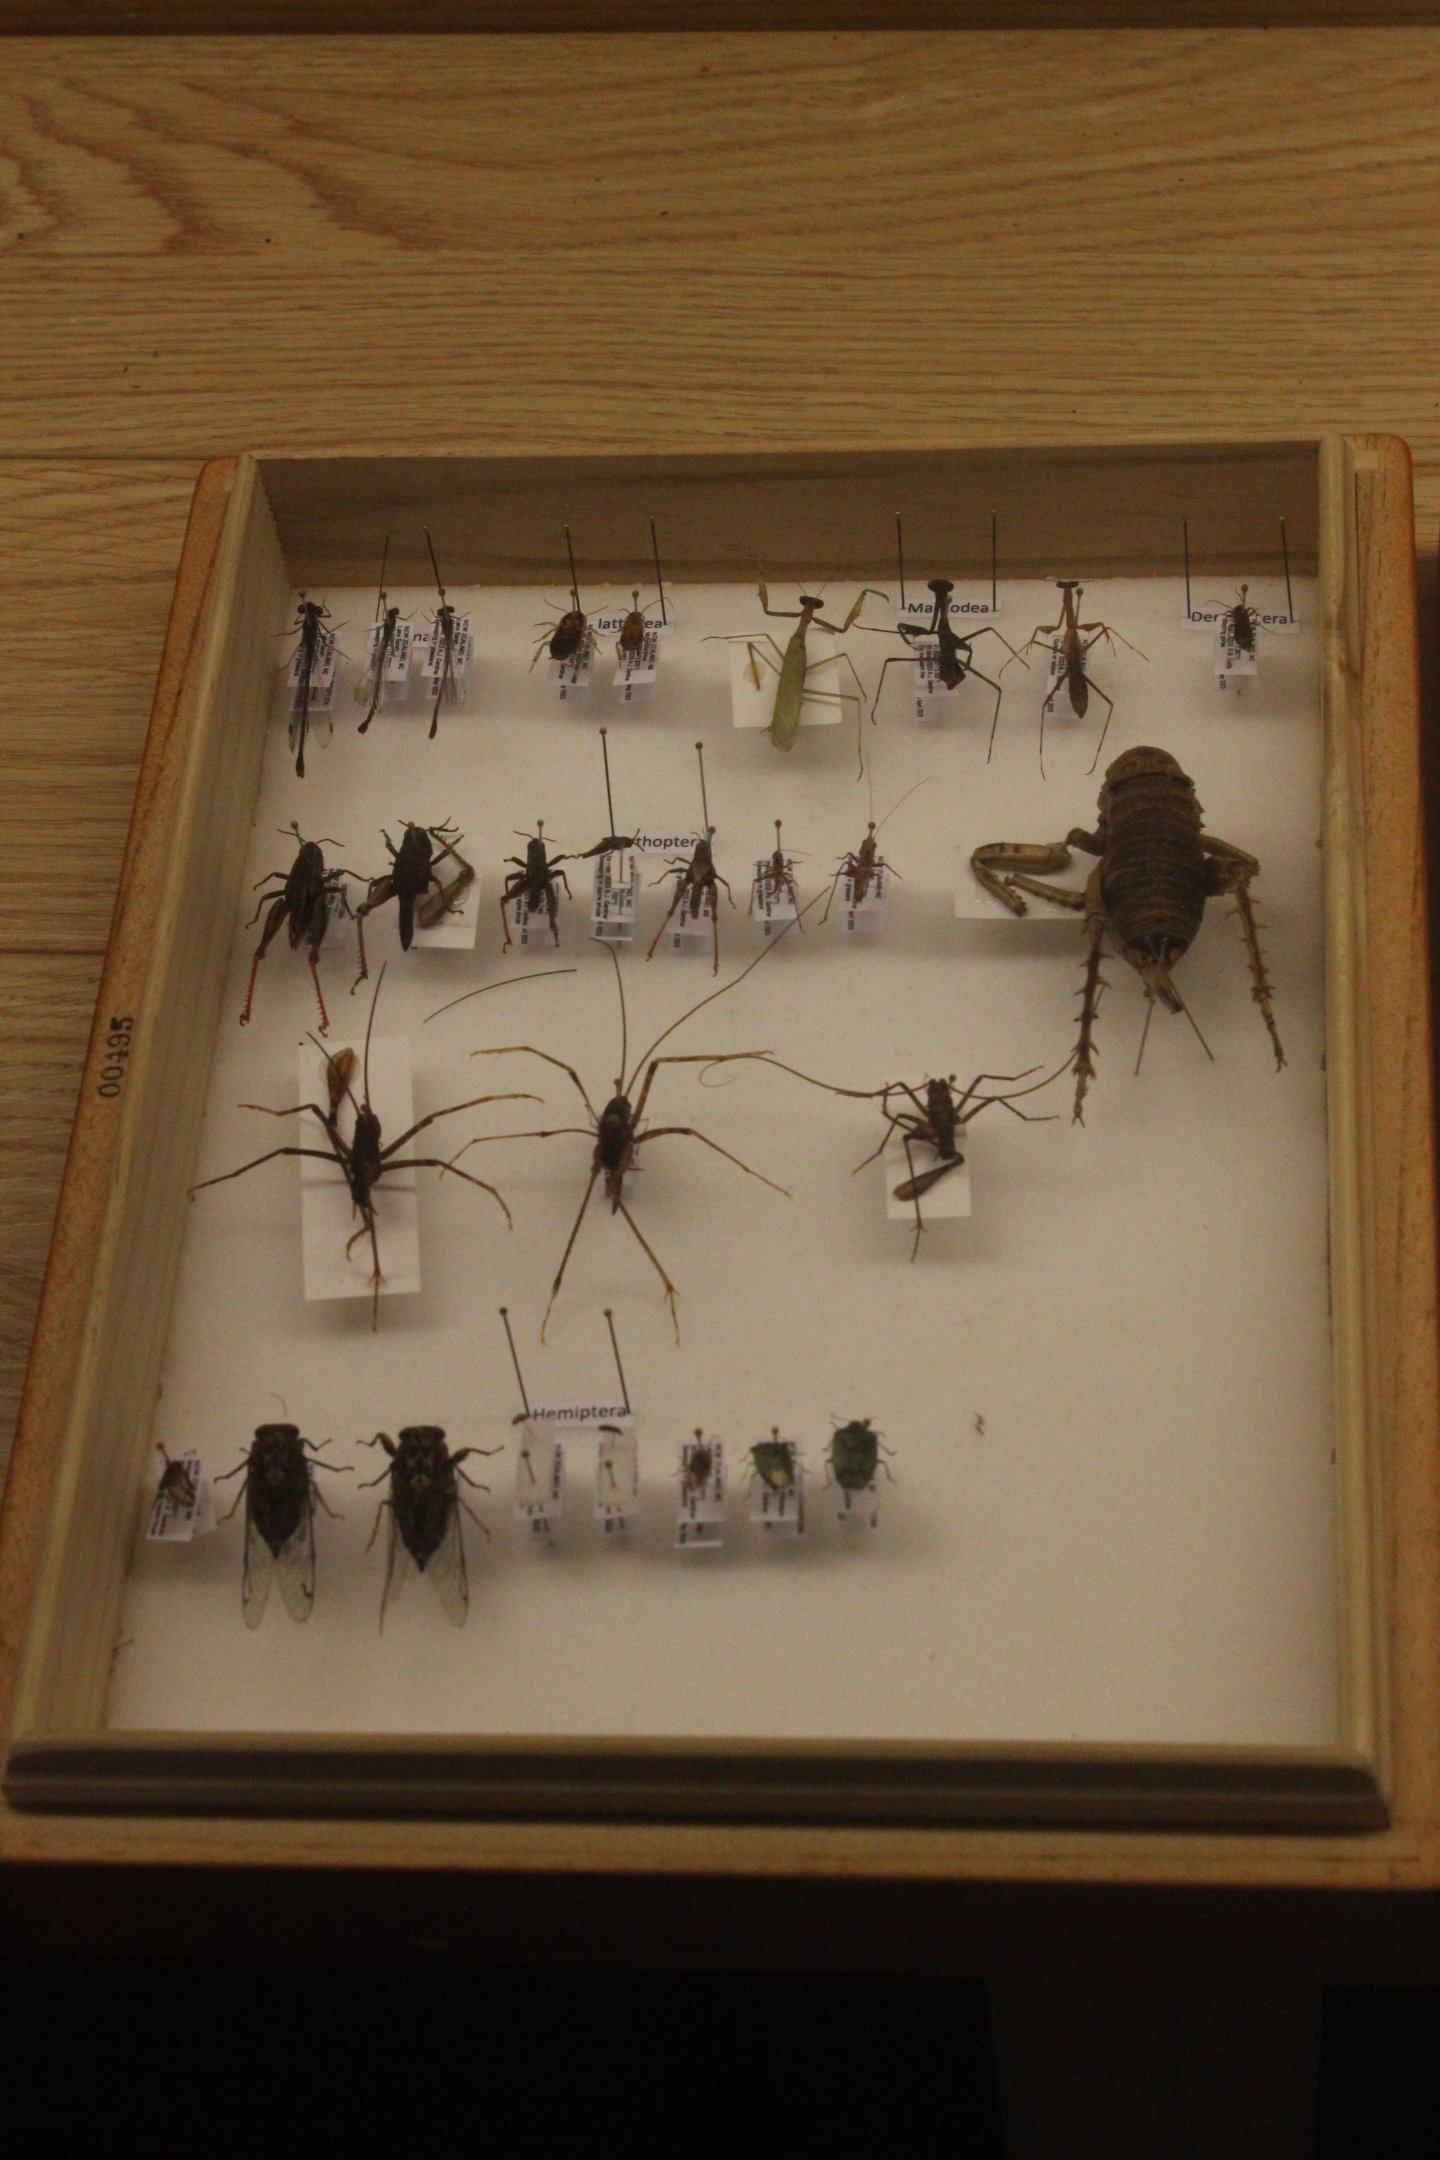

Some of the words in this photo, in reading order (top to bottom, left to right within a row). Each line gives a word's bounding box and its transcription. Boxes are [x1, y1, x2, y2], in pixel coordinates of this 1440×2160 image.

[908, 602, 989, 613] Maodea
[1191, 612, 1287, 624] Derera
[637, 836, 697, 849] thopter
[533, 1406, 626, 1421] Hemiptera
